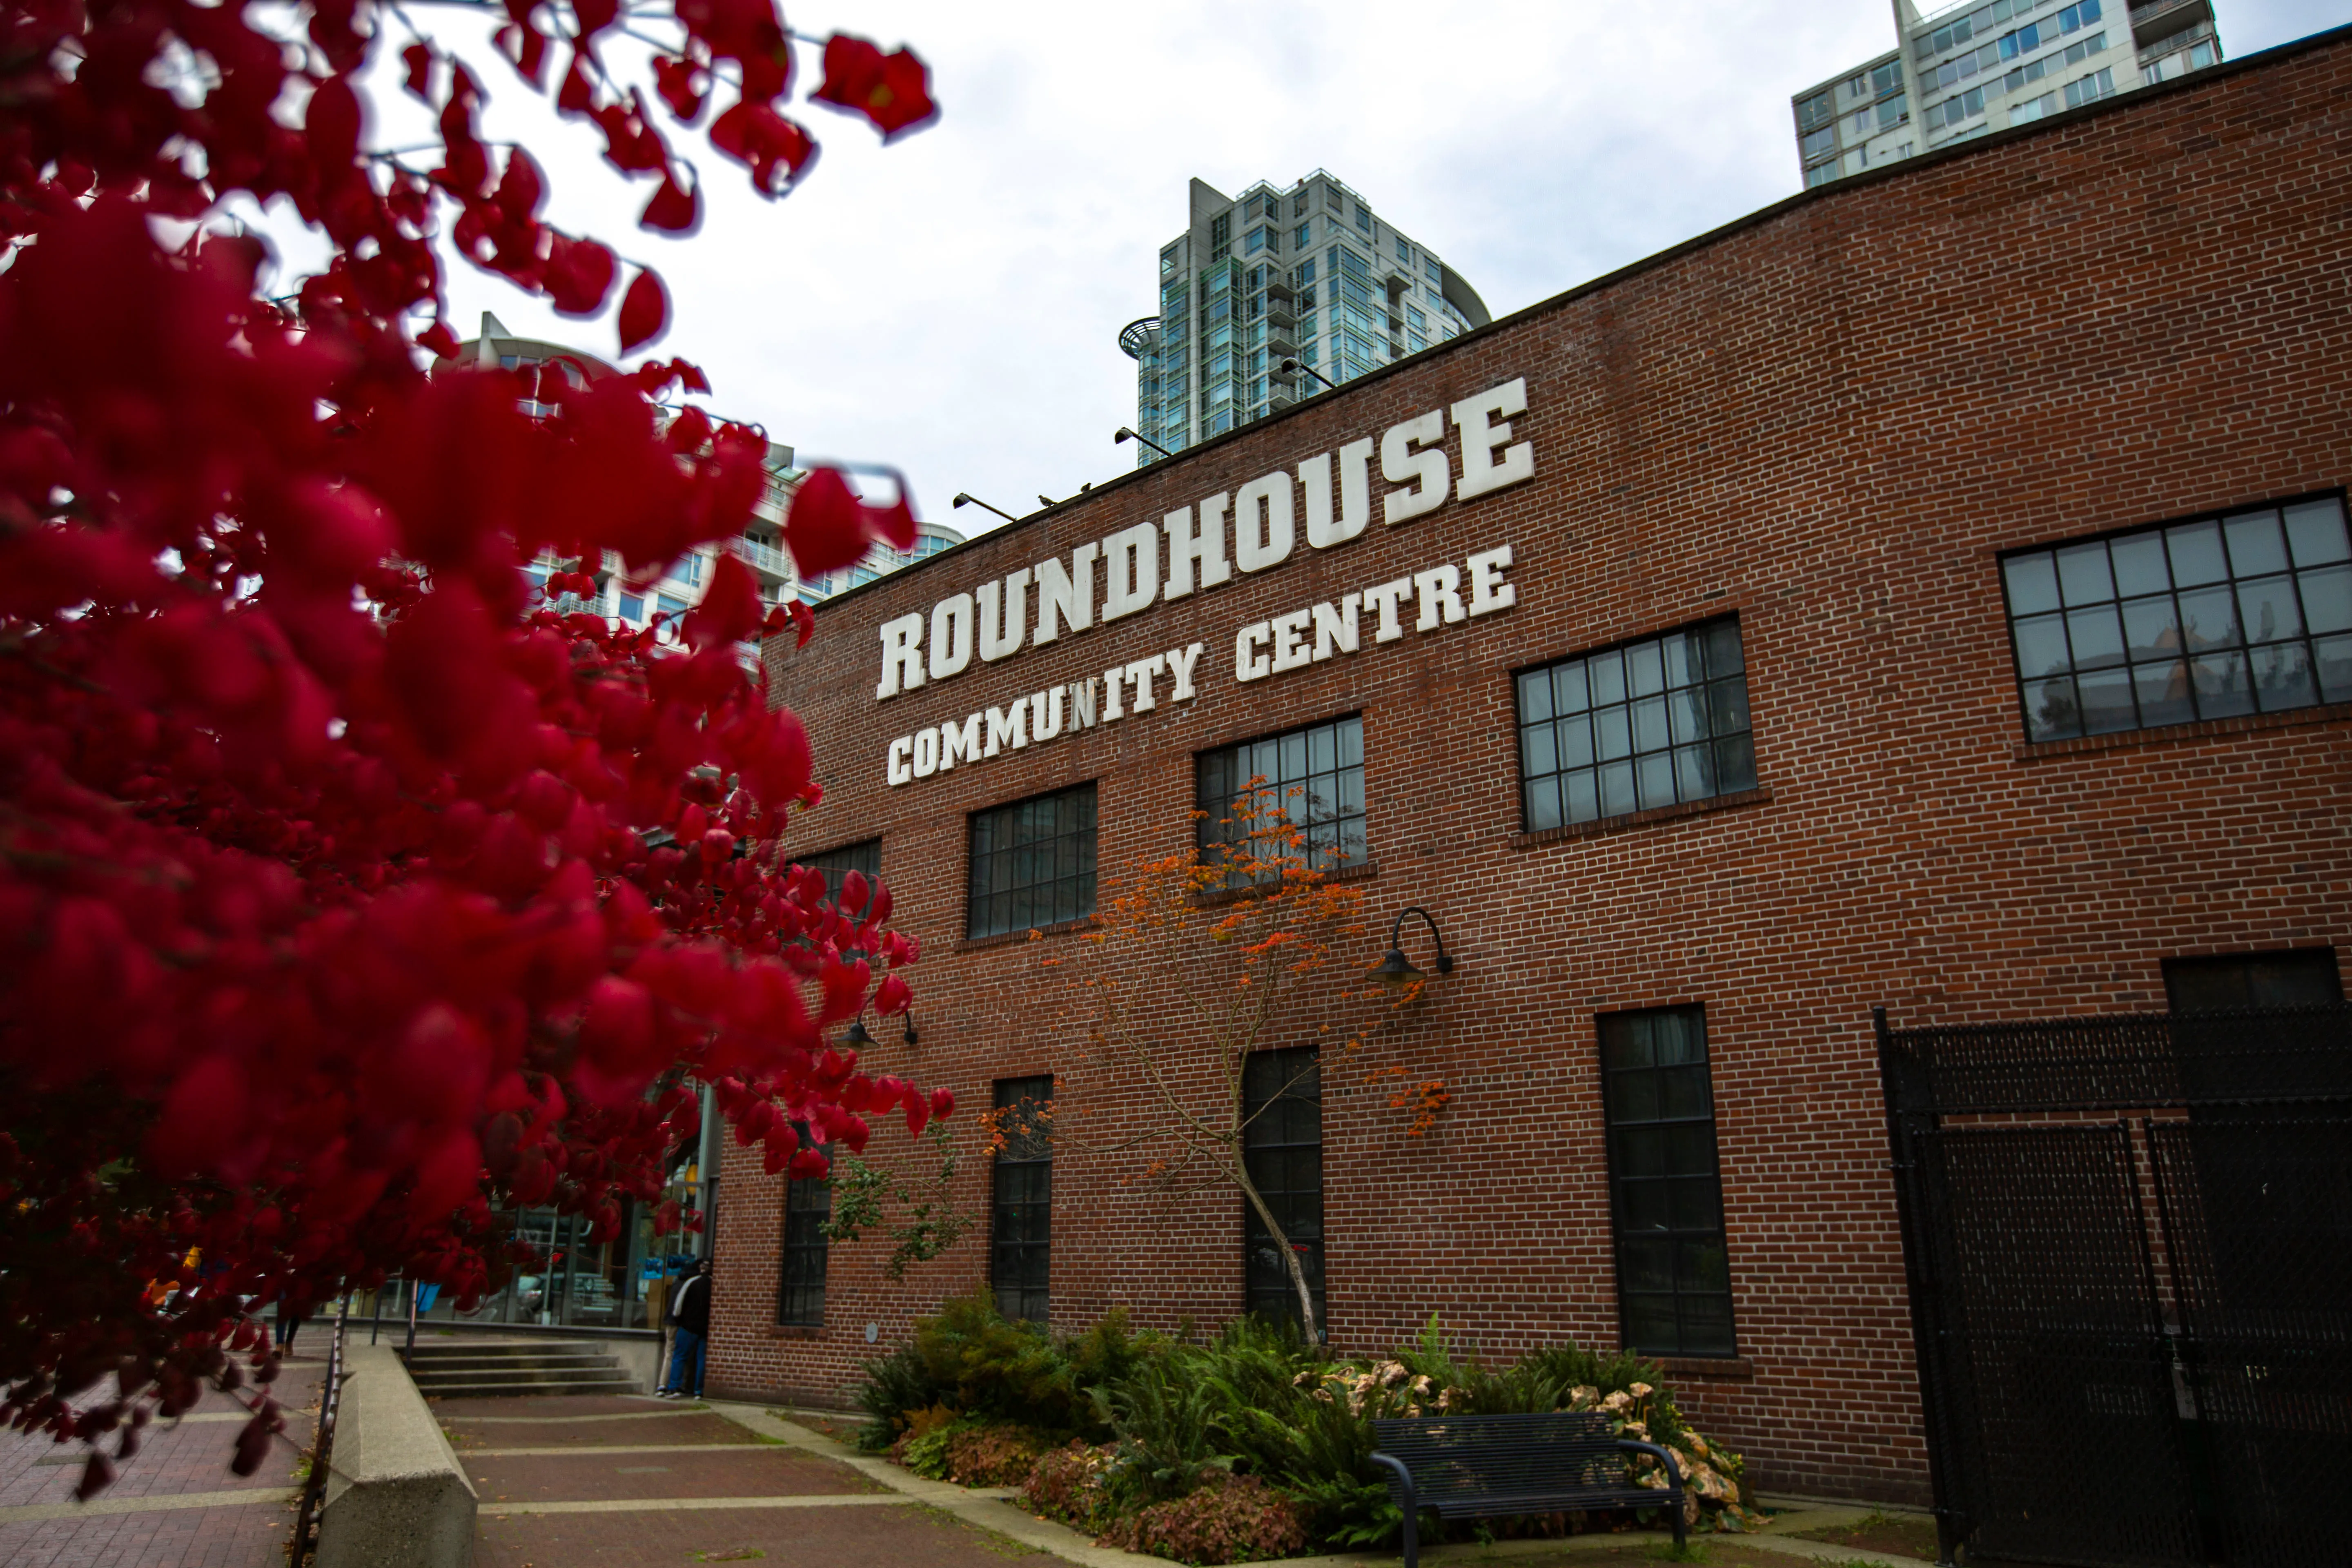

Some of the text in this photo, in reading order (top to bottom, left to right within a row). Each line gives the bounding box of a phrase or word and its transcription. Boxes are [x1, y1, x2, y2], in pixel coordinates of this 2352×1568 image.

[877, 377, 1535, 701] ROUNDHOUSE
[888, 545, 1516, 786] COMMUNITY CENTRE
